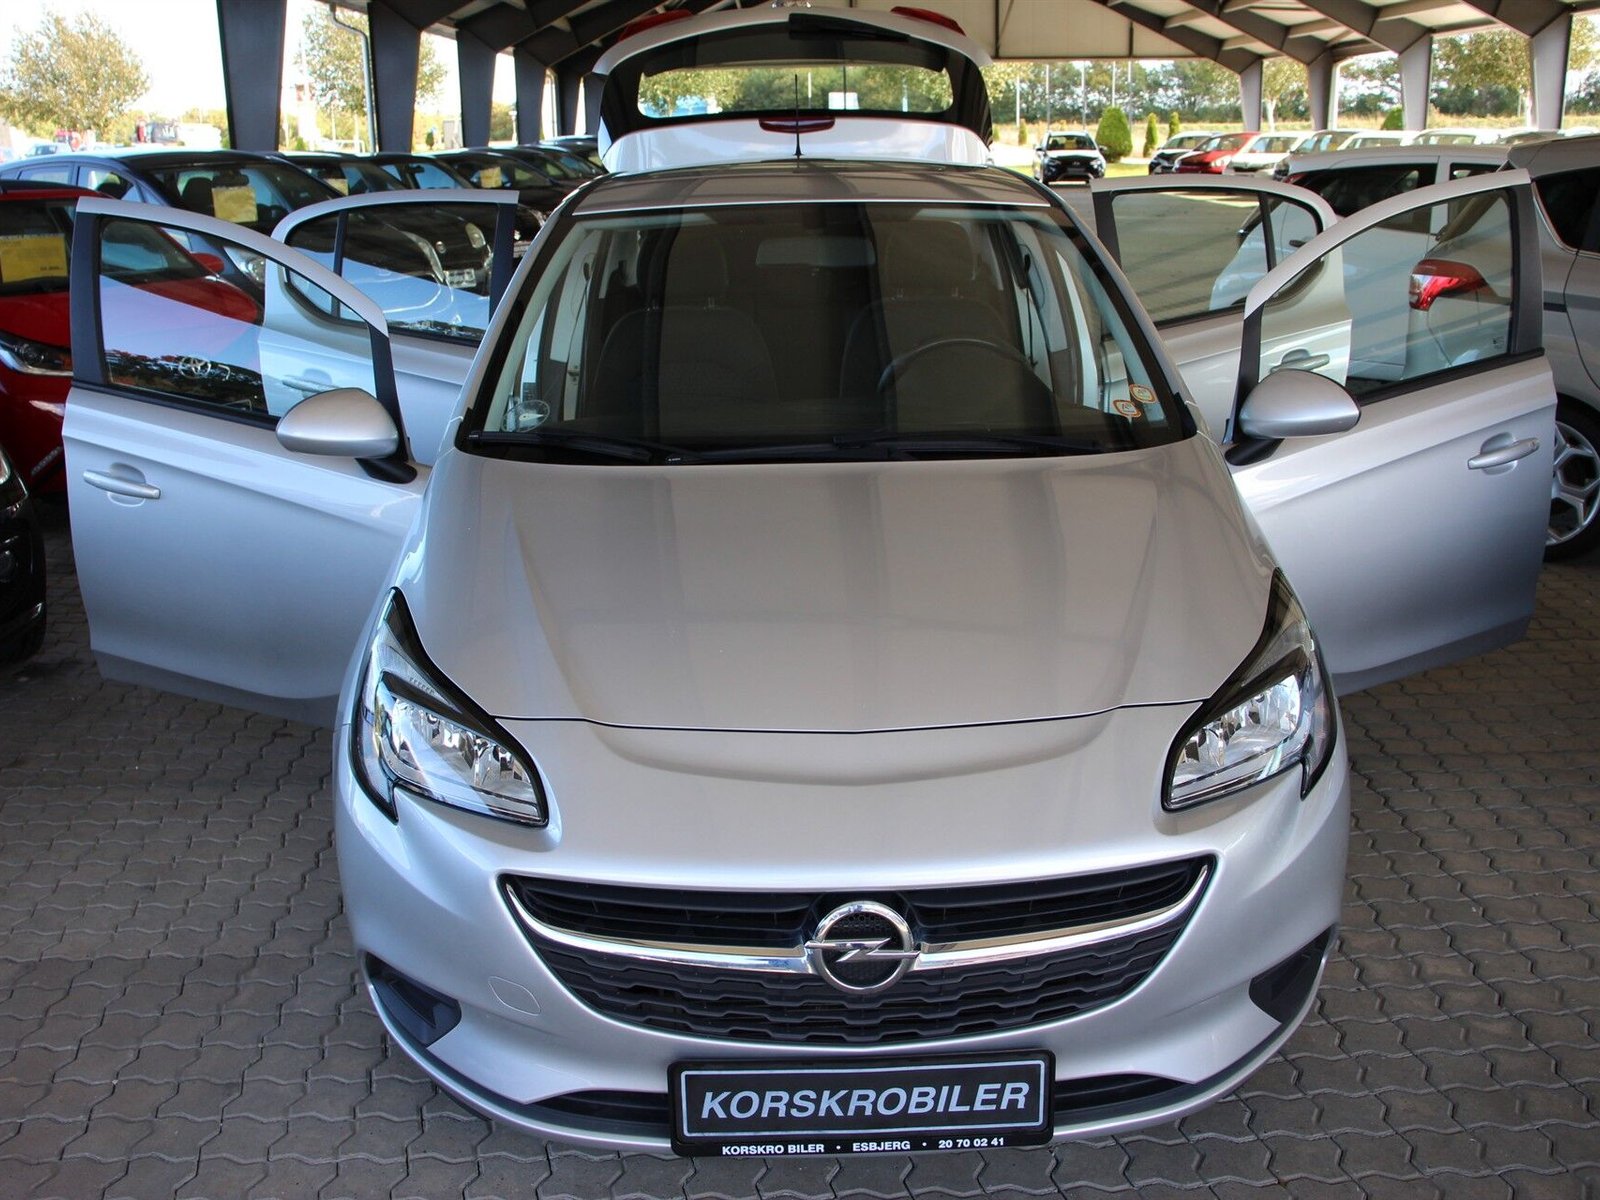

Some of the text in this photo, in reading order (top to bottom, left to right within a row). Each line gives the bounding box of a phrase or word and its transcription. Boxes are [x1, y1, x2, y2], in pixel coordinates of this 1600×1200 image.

[701, 1082, 1030, 1119] KORSKROBILER
[722, 1137, 1004, 1155] KORSKRO BILER ESBJERG 20 70 02 41
